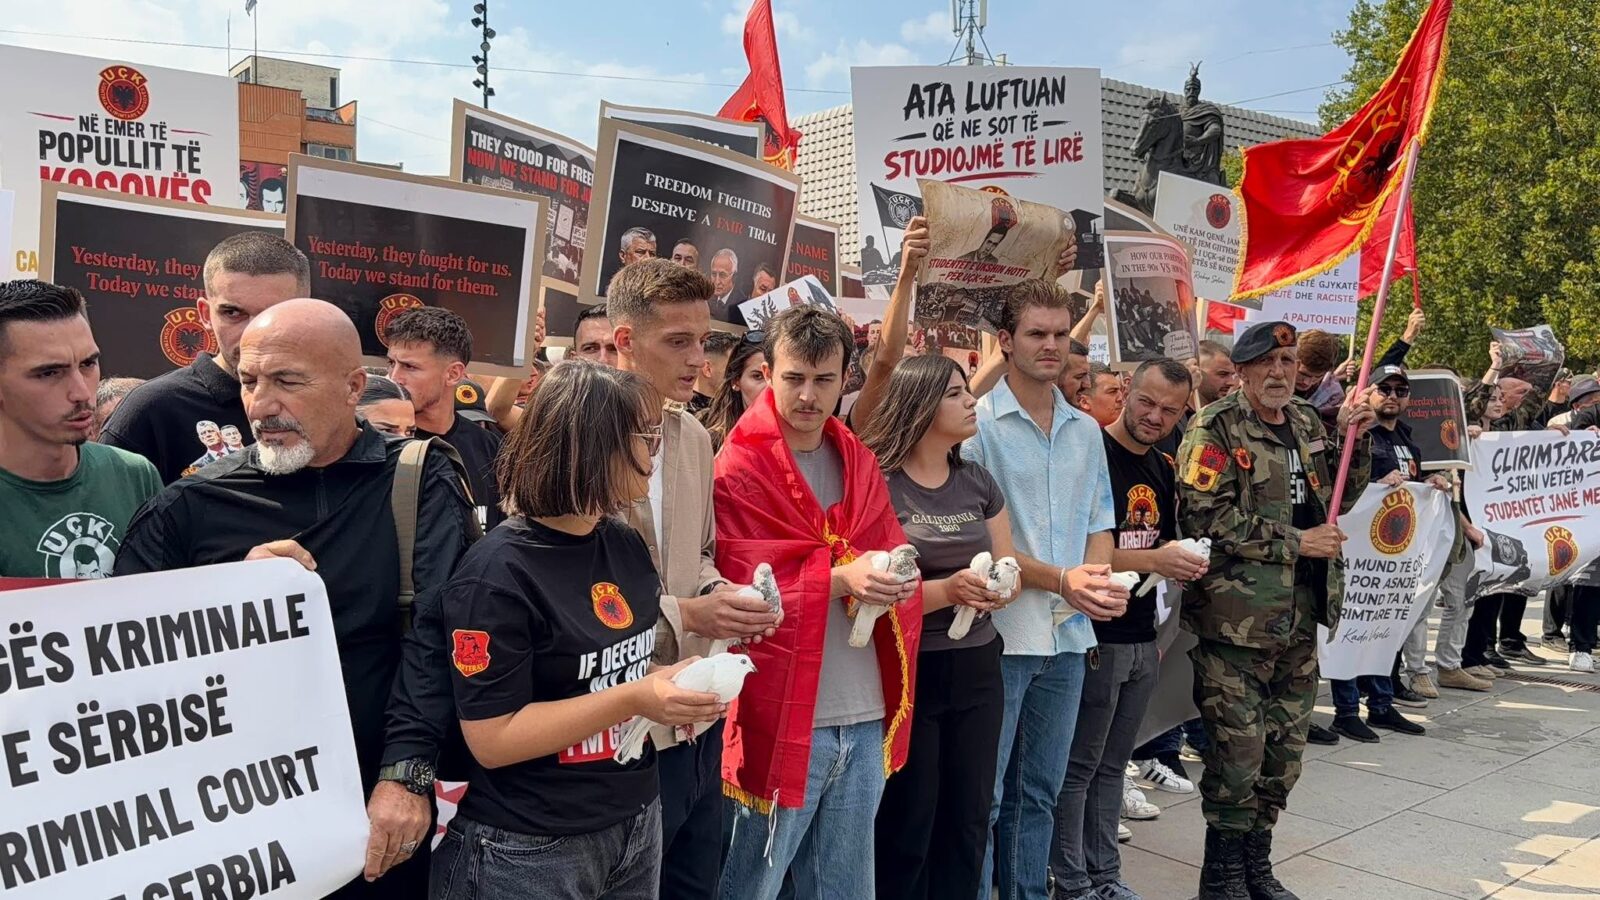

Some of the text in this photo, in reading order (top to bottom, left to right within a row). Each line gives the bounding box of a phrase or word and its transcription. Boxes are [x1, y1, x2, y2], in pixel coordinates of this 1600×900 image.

[103, 67, 143, 85] UÇK
[903, 74, 1066, 122] ATA LUFTUAN
[78, 113, 168, 141] NË EMER TË
[932, 111, 1039, 142] QË NE SOT TË
[39, 129, 201, 174] POPULLIT TË
[471, 130, 502, 154] THEY
[504, 142, 544, 168] STOOD
[546, 156, 568, 176] FOR
[884, 131, 1084, 181] STUDIOJMË TË LIRË
[467, 147, 496, 172] NOW
[499, 159, 518, 178] WE
[520, 163, 558, 192] STAND
[560, 177, 579, 199] FOR
[645, 172, 773, 219] FREEDOM FIGHTERS
[631, 195, 778, 246] DESERVE A FAIR TRIAL
[1173, 223, 1189, 233] UNË
[1189, 227, 1205, 238] KAM
[795, 242, 829, 261] NAME
[1188, 236, 1197, 246] TË
[1197, 239, 1211, 249] JEM
[16, 249, 38, 272] CA
[70, 246, 202, 281] Yesterday, they
[307, 235, 512, 278] Yesterday, they fought for us.
[1121, 264, 1131, 273] IN
[1131, 264, 1147, 272] THE
[1160, 263, 1171, 273] VS
[1130, 252, 1148, 261] HOW
[1149, 252, 1163, 260] OUR
[318, 261, 498, 296] Today we stand for them.
[977, 262, 1006, 274] UKSHIN
[1005, 265, 1031, 278] HOTIT
[1333, 268, 1340, 277] E
[86, 272, 141, 297] Today
[145, 283, 170, 297] we
[1295, 291, 1313, 300] DHE
[1318, 280, 1358, 290] GJYKATË
[1282, 312, 1356, 326] A PAJTOHENI?
[1507, 466, 1584, 494] SJENI VETËM
[1484, 494, 1546, 523] STUDENTËT
[1549, 487, 1580, 513] JANË
[911, 511, 978, 526] CALIFORNIA
[43, 516, 108, 553] UÇK
[1545, 526, 1569, 543] UÇK
[1353, 558, 1397, 573] MUND
[1399, 558, 1412, 573] TË
[1350, 575, 1416, 589] POR ASNJË
[1345, 592, 1385, 606] MUND
[1387, 593, 1399, 604] TA
[1394, 606, 1410, 620] TË
[84, 592, 311, 677] KRIMINALE
[577, 651, 598, 681] IF
[47, 673, 234, 776] SËRBISË
[0, 745, 321, 890] RIMINAL COURT
